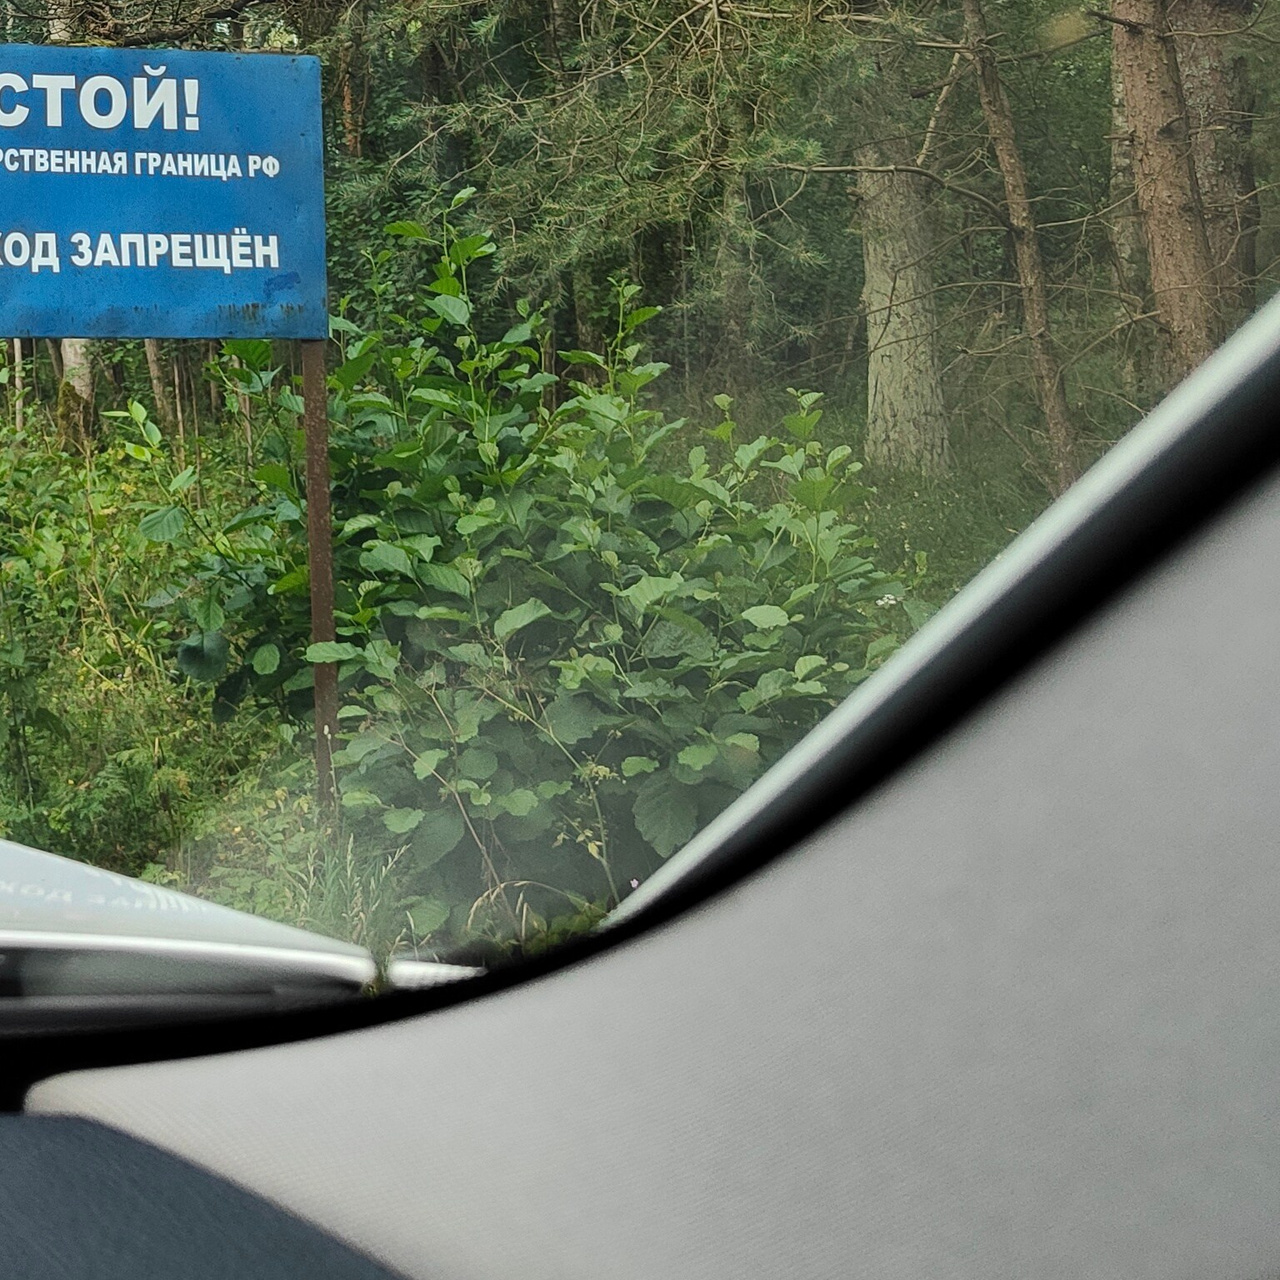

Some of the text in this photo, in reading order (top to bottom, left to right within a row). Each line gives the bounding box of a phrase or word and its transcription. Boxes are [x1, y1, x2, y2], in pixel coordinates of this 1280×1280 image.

[134, 151, 243, 181] ГРАНИЦА
[247, 154, 281, 178] РФ
[70, 227, 280, 275] ЗАПРЕЩЁН
